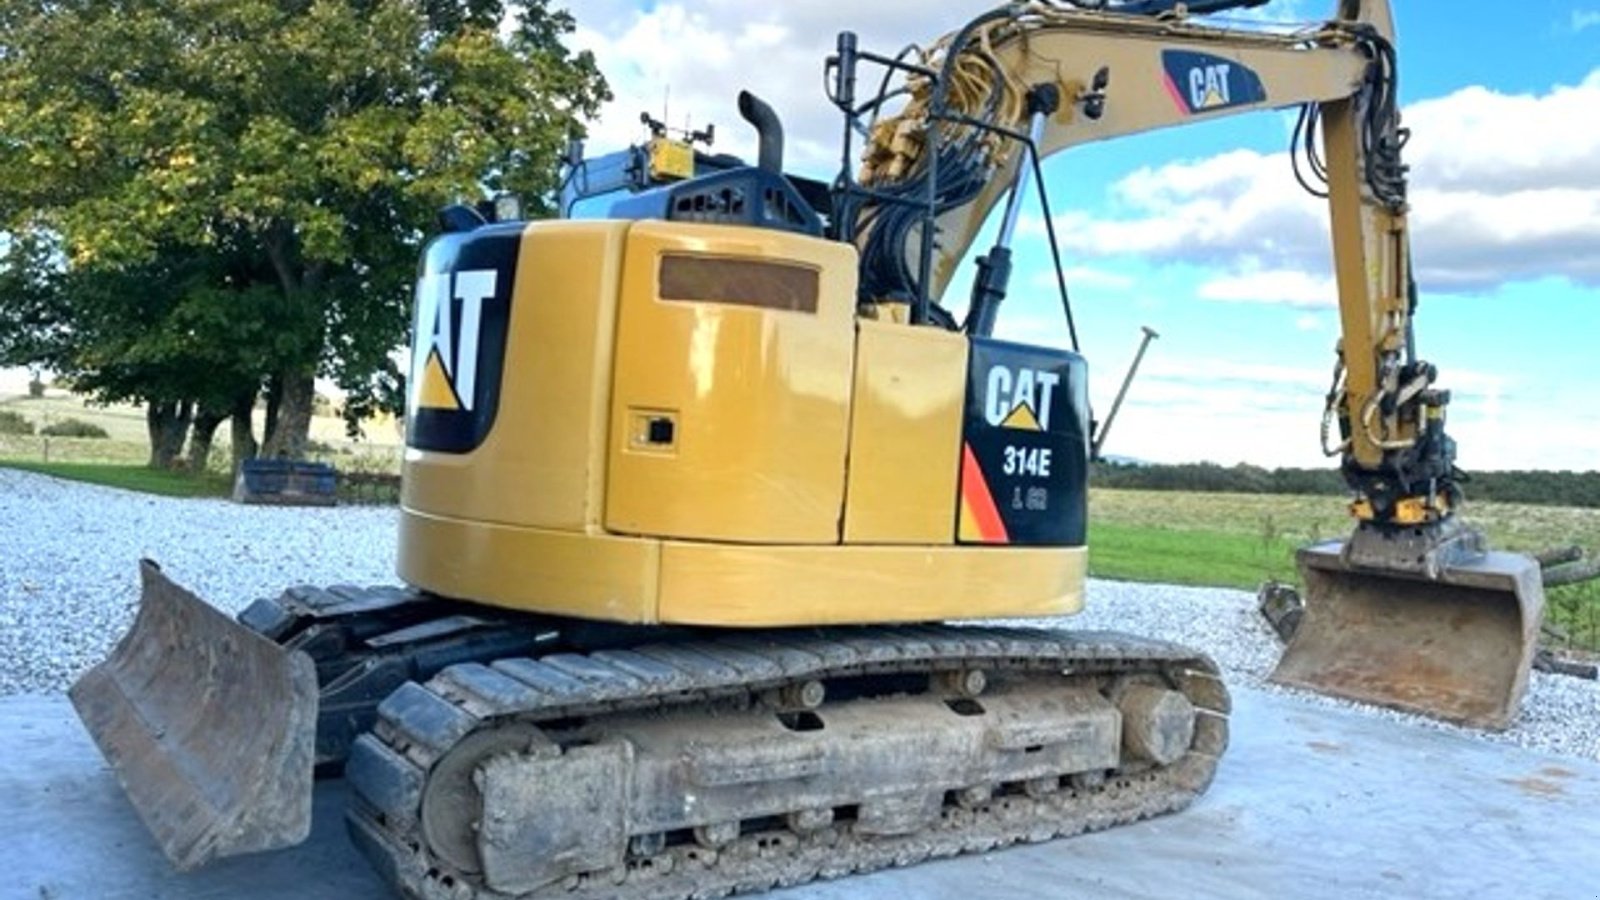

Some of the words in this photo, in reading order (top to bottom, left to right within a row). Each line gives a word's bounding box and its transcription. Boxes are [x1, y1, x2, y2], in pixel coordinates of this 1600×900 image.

[1188, 64, 1230, 109] CAT
[410, 269, 498, 412] AT
[985, 365, 1060, 432] CAT
[1003, 445, 1052, 477] 314E
